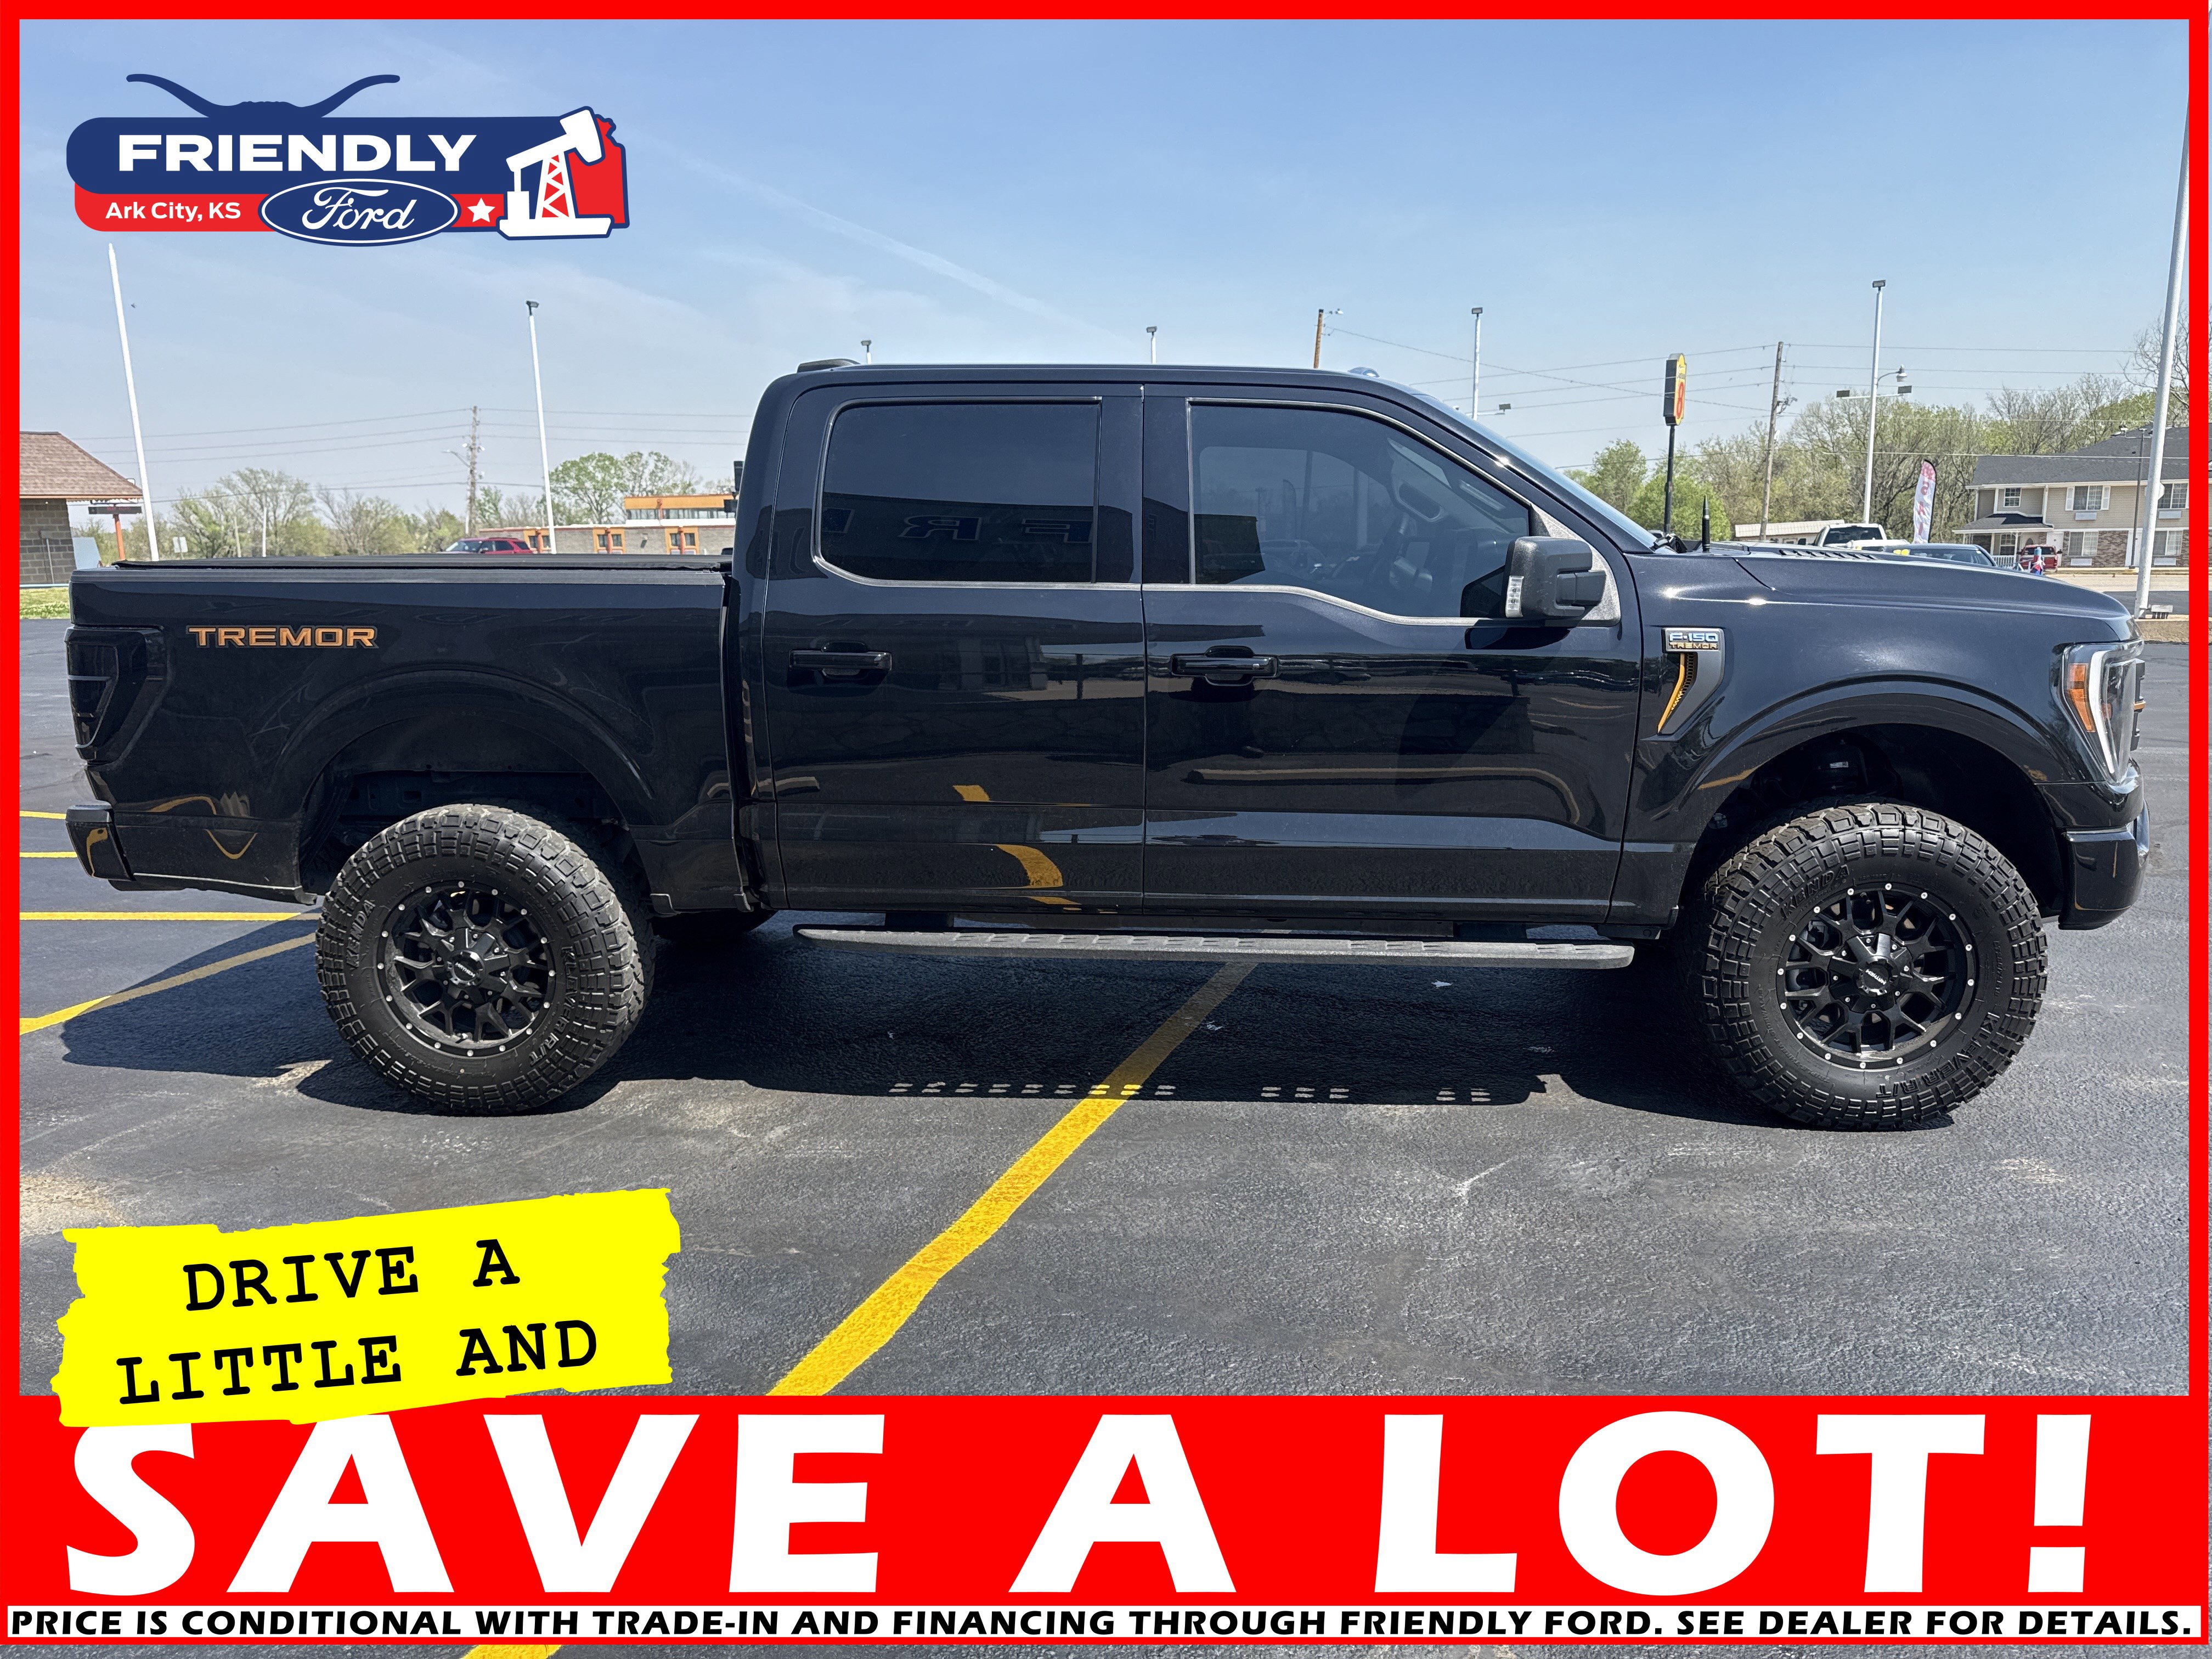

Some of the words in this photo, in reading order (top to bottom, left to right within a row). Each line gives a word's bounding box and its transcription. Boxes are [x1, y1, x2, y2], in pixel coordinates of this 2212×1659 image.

[189, 626, 377, 648] TREMOR
[1669, 632, 1719, 642] F-150
[1780, 864, 1849, 921] KENDA
[346, 900, 375, 968] KENDA
[554, 946, 578, 1034] KLEVER
[529, 1032, 560, 1066] R/T
[1922, 1012, 2000, 1088] KLEVER
[1876, 1077, 1920, 1099] R/T
